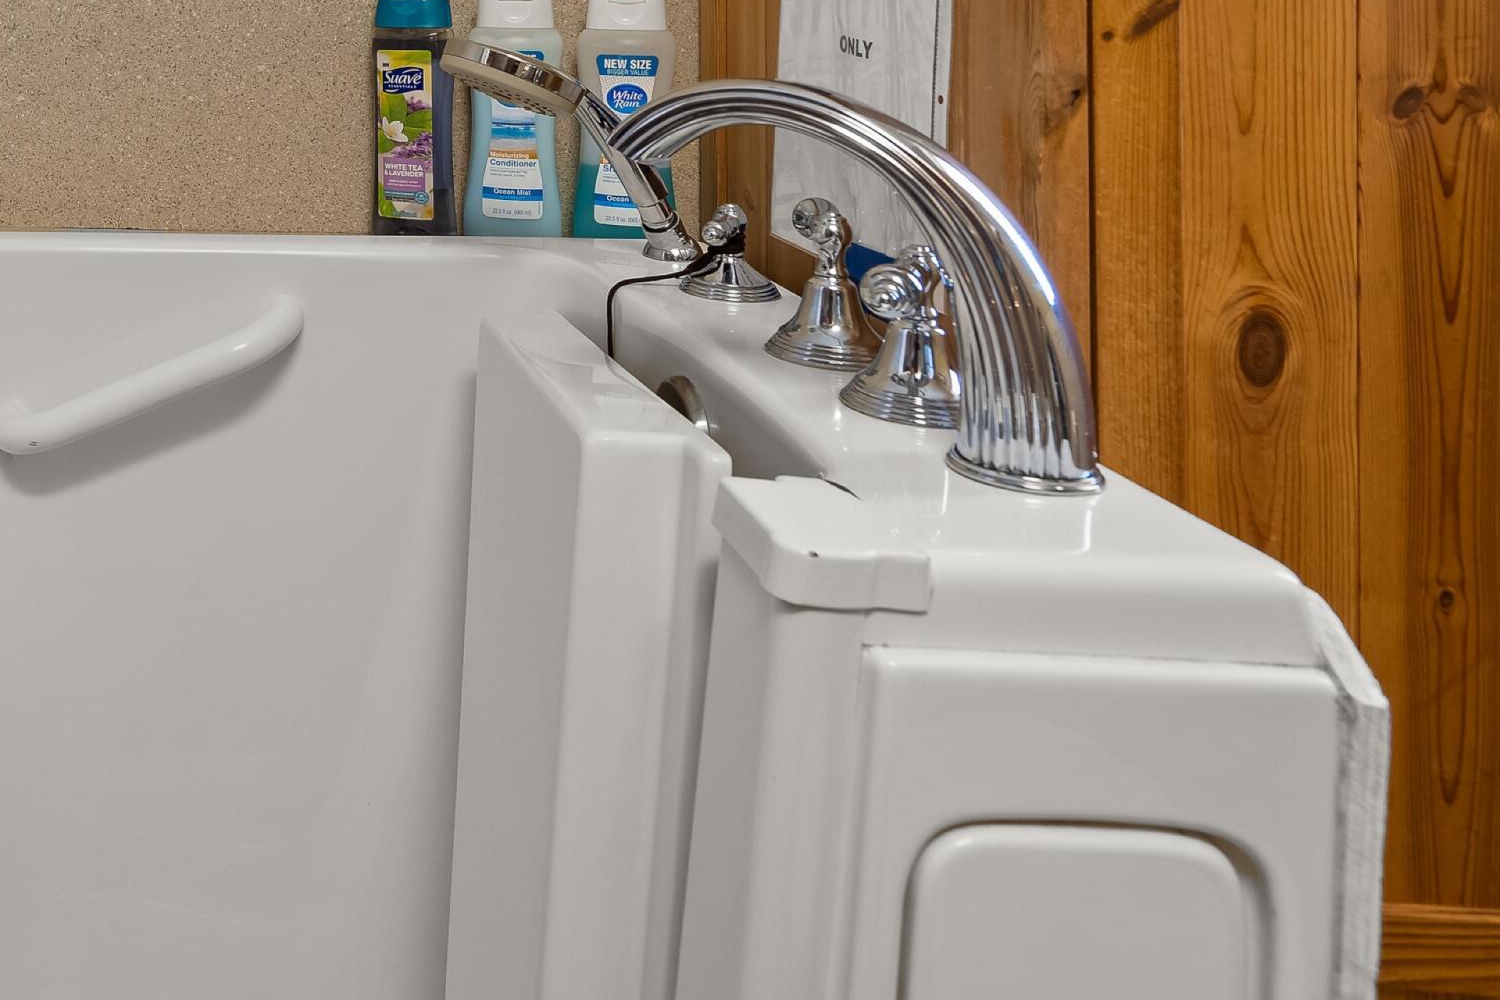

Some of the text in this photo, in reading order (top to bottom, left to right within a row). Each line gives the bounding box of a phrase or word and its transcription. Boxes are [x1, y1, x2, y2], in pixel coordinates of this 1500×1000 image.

[839, 34, 874, 59] ONLY
[604, 58, 652, 70] NEW SIZE
[606, 68, 629, 76] BIGGER
[384, 70, 422, 85] Suave
[612, 90, 644, 101] White
[613, 99, 640, 109] Rain
[490, 151, 530, 159] Moisturizing
[384, 162, 423, 172] WHITE TEA
[489, 158, 537, 168] Conditioner
[389, 170, 424, 178] LAVENDER
[493, 188, 532, 197] Ocean Mist
[606, 195, 630, 203] Ocean
